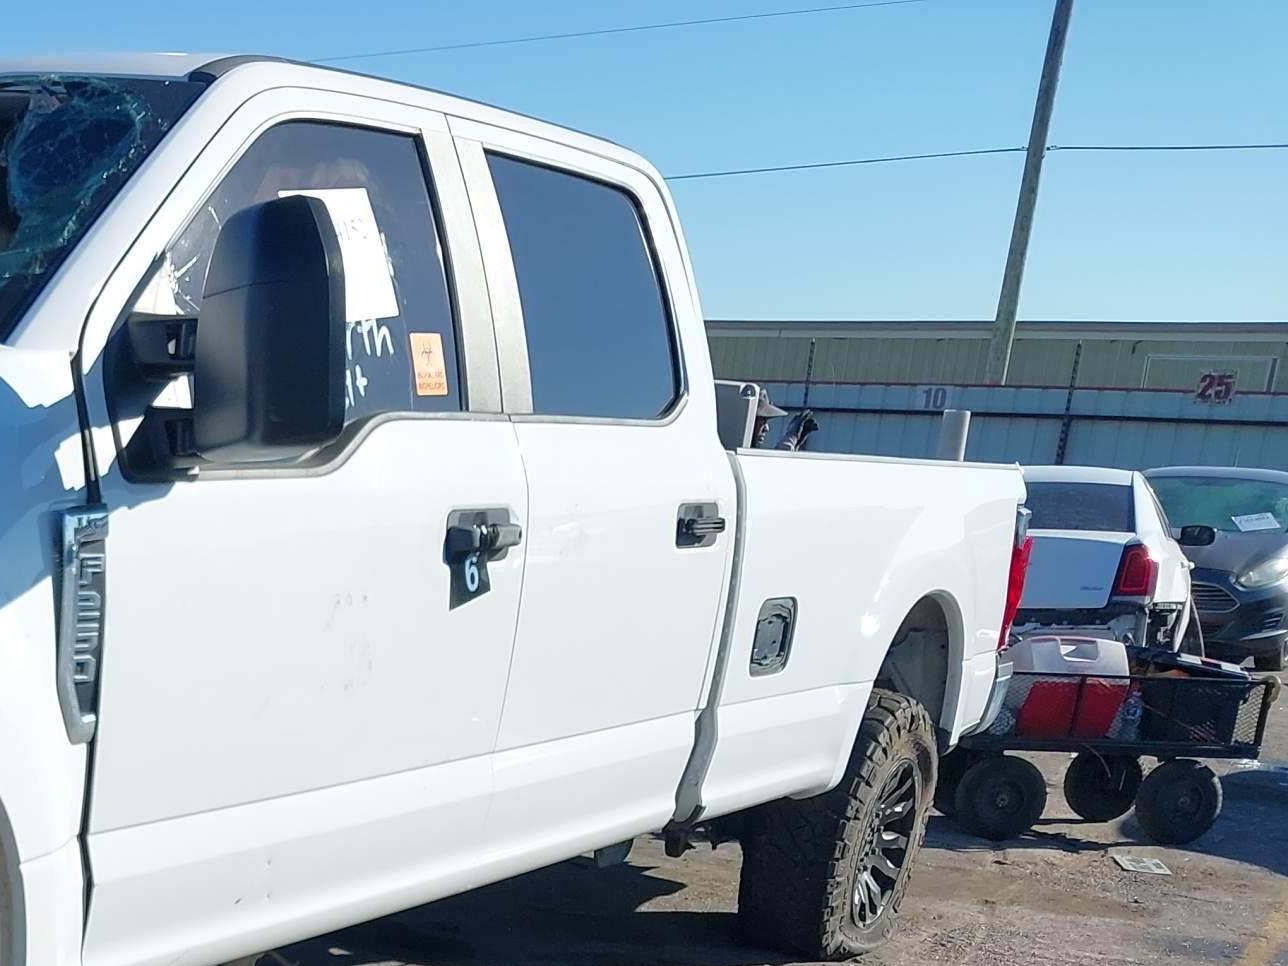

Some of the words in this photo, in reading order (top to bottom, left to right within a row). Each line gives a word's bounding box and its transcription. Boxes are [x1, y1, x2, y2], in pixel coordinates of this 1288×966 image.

[922, 387, 947, 409] 10
[1197, 374, 1234, 402] 25
[464, 552, 480, 593] 6
